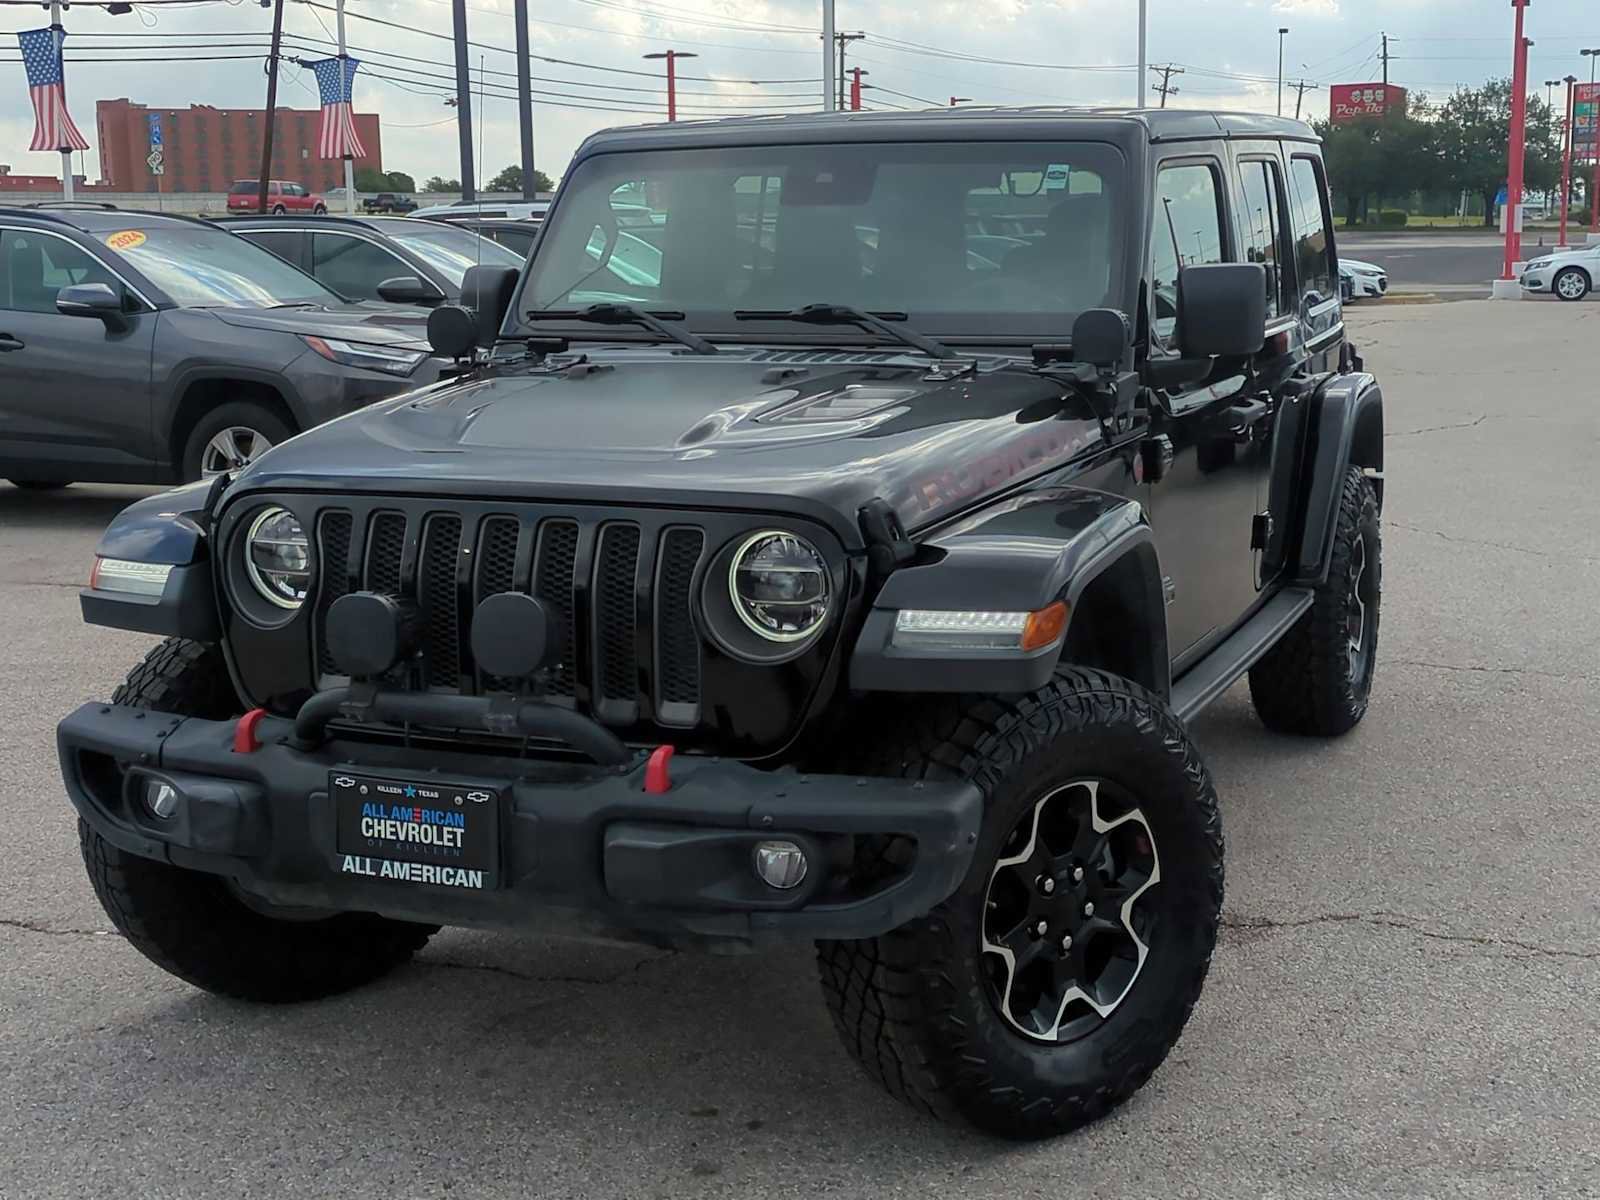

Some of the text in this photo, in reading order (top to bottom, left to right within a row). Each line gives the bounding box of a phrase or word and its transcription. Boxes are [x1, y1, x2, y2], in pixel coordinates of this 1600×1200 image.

[110, 231, 142, 247] 2024
[377, 785, 440, 799] KILLEEN TEXAS
[362, 802, 465, 827] ALL AMERICAN
[361, 816, 465, 848] CHEVROLET
[342, 855, 483, 889] ALL AMERICAN
